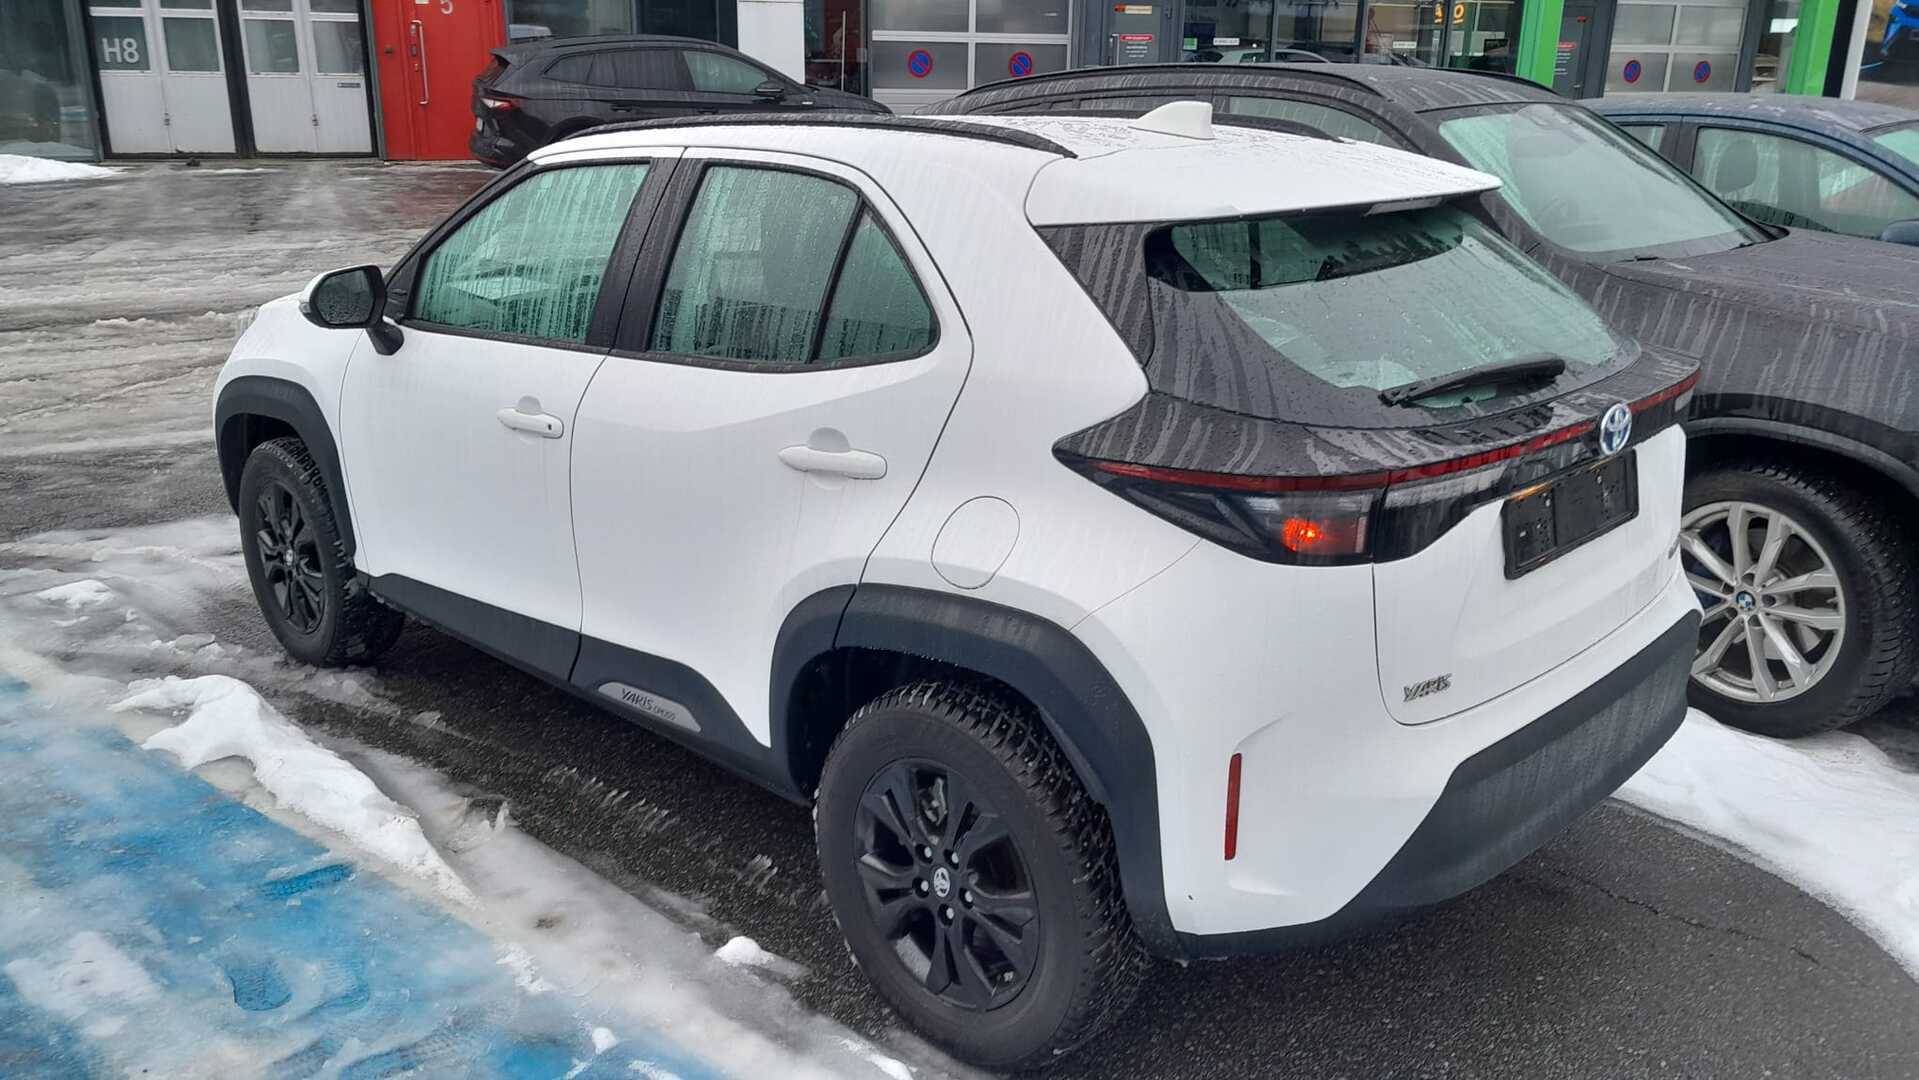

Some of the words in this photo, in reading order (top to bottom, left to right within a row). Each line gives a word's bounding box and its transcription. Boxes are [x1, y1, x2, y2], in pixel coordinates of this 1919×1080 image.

[102, 37, 139, 63] H8
[621, 687, 653, 710] YARIS
[1403, 673, 1452, 702] YARIS
